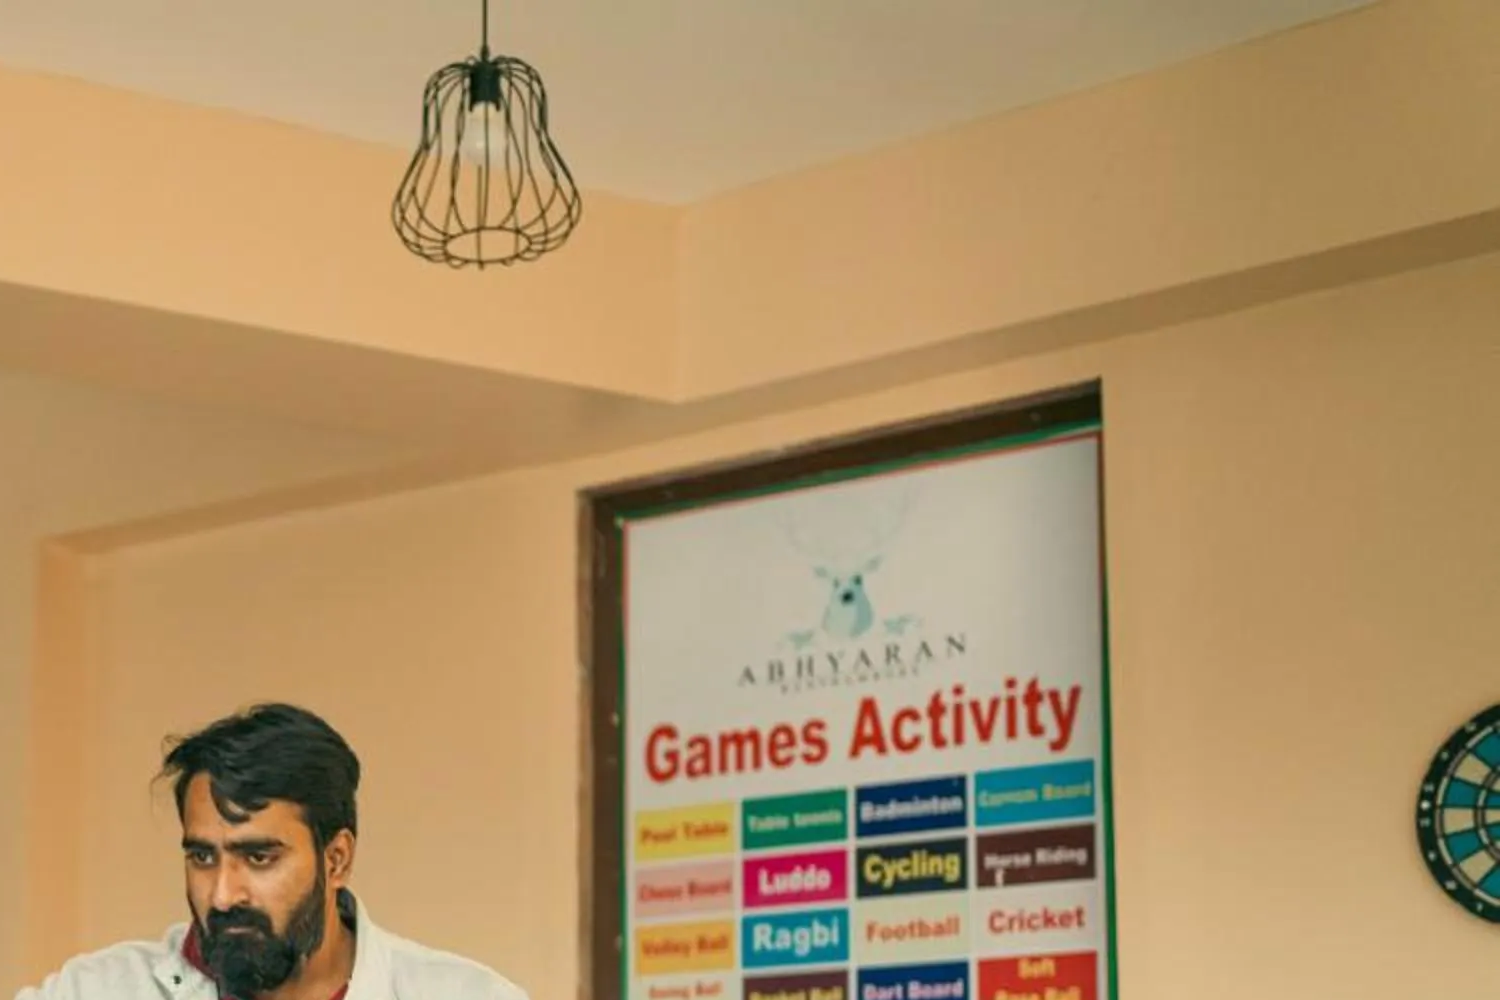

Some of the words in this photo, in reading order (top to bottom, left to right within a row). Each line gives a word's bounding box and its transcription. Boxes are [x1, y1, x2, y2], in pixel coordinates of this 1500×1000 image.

[737, 634, 967, 687] ABHYARAN
[644, 718, 829, 784] Games
[848, 677, 1082, 754] Activity
[860, 796, 963, 822] Badminton
[864, 849, 961, 888] Cycling
[984, 853, 1031, 869] Horse
[1036, 846, 1088, 866] Riding
[758, 864, 832, 895] Luddo
[866, 915, 961, 941] Football
[989, 906, 1086, 934] Cricket
[753, 916, 839, 957] Ragbi
[908, 979, 964, 1000] Board
